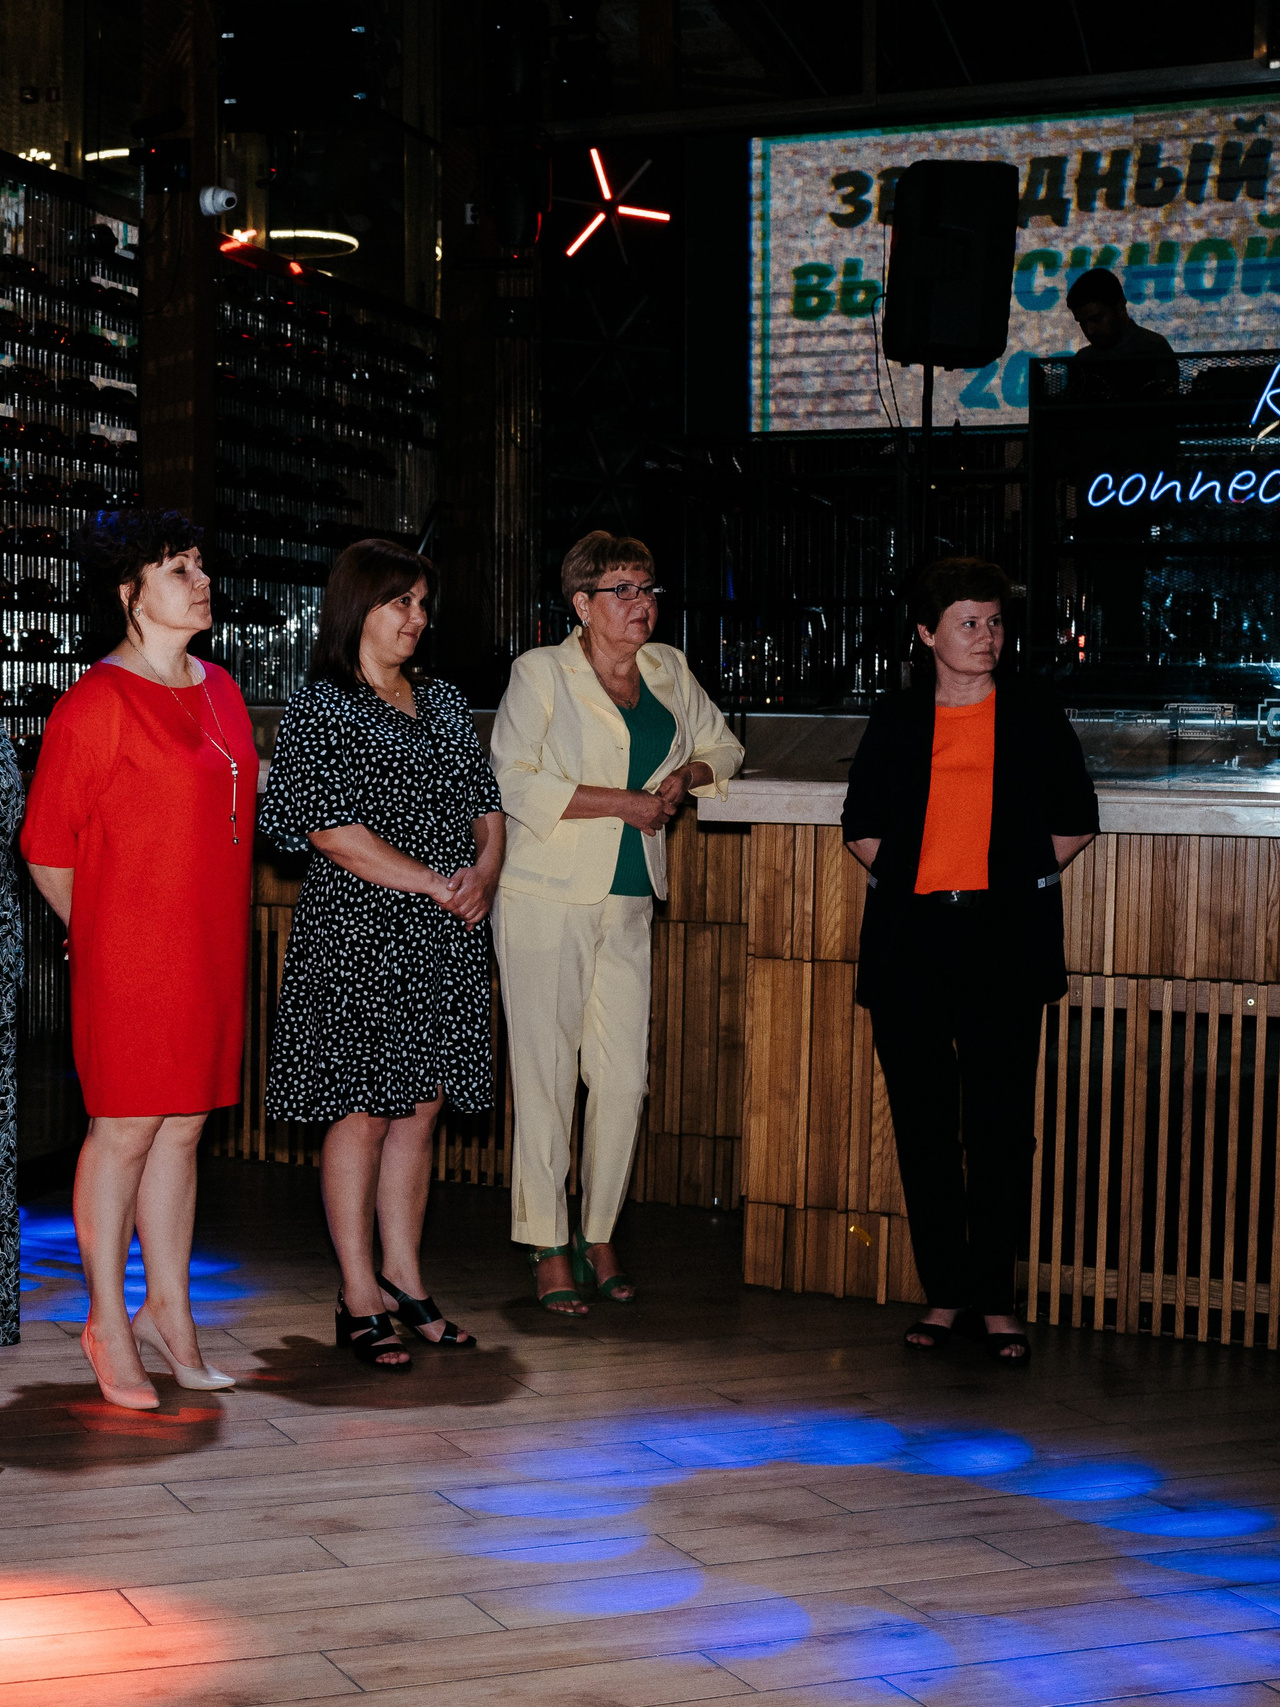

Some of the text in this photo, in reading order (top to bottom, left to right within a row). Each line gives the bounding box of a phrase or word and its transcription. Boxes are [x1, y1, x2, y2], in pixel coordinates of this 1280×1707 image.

[828, 115, 1274, 228] ЗДНЫЙ
[791, 211, 1280, 321] ВЫСКНОЙ
[959, 350, 1077, 410] 20
